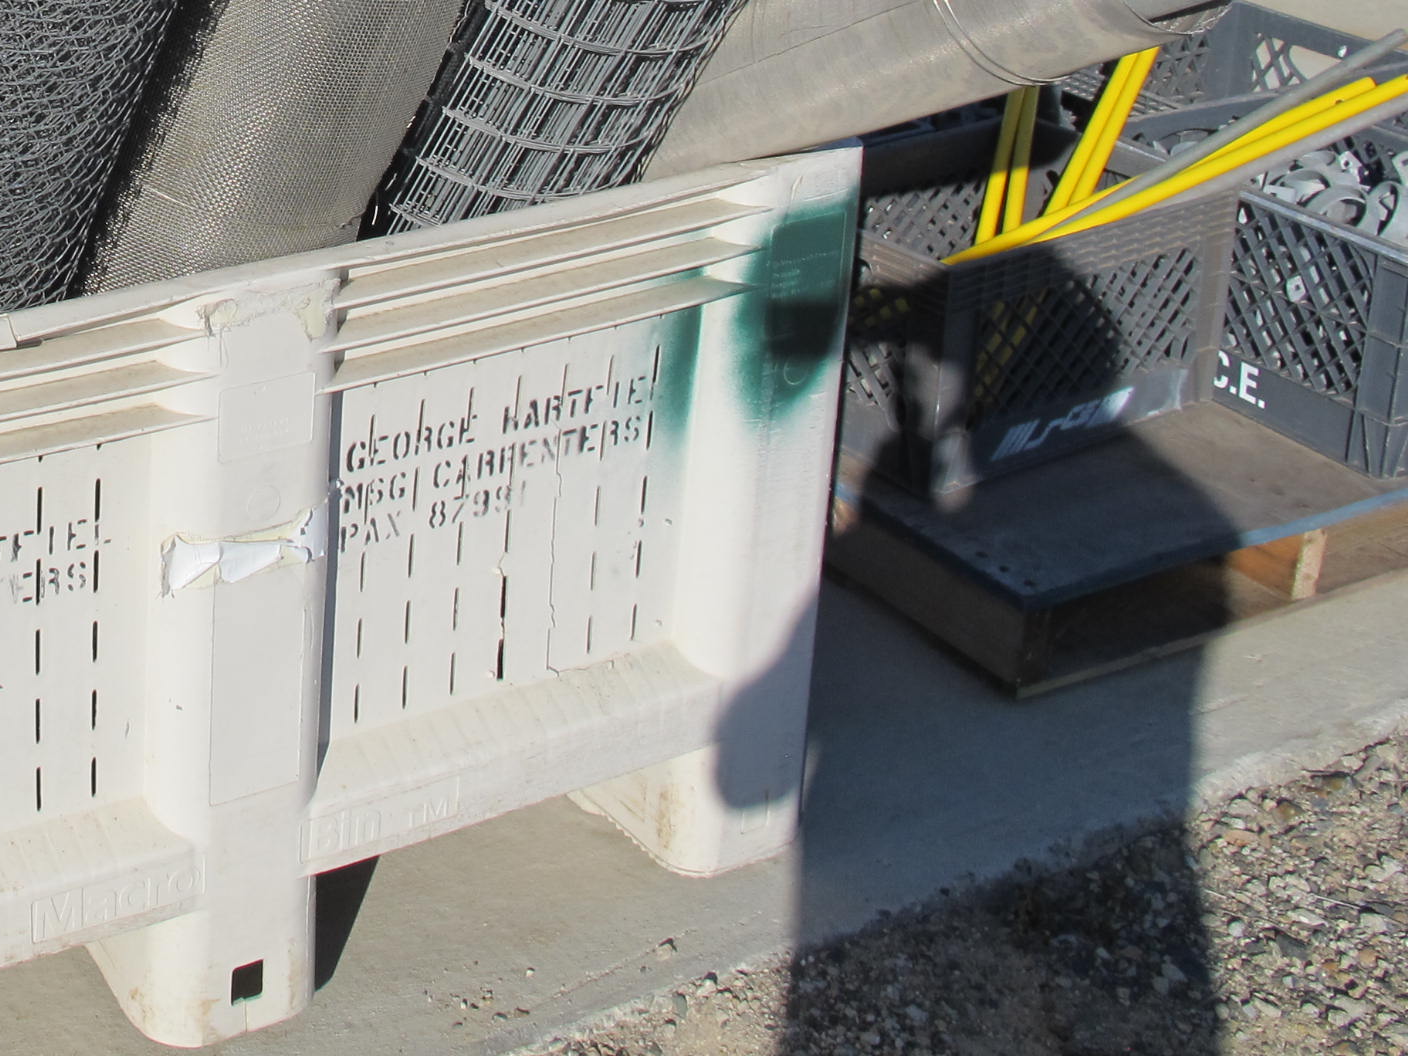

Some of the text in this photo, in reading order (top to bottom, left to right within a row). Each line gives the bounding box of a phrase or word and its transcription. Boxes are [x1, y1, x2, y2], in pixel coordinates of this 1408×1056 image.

[343, 416, 641, 514] MSG CARPENTERS
[346, 415, 477, 472] GEORGE
[340, 509, 401, 553] PAX
[33, 866, 201, 941] Macro
